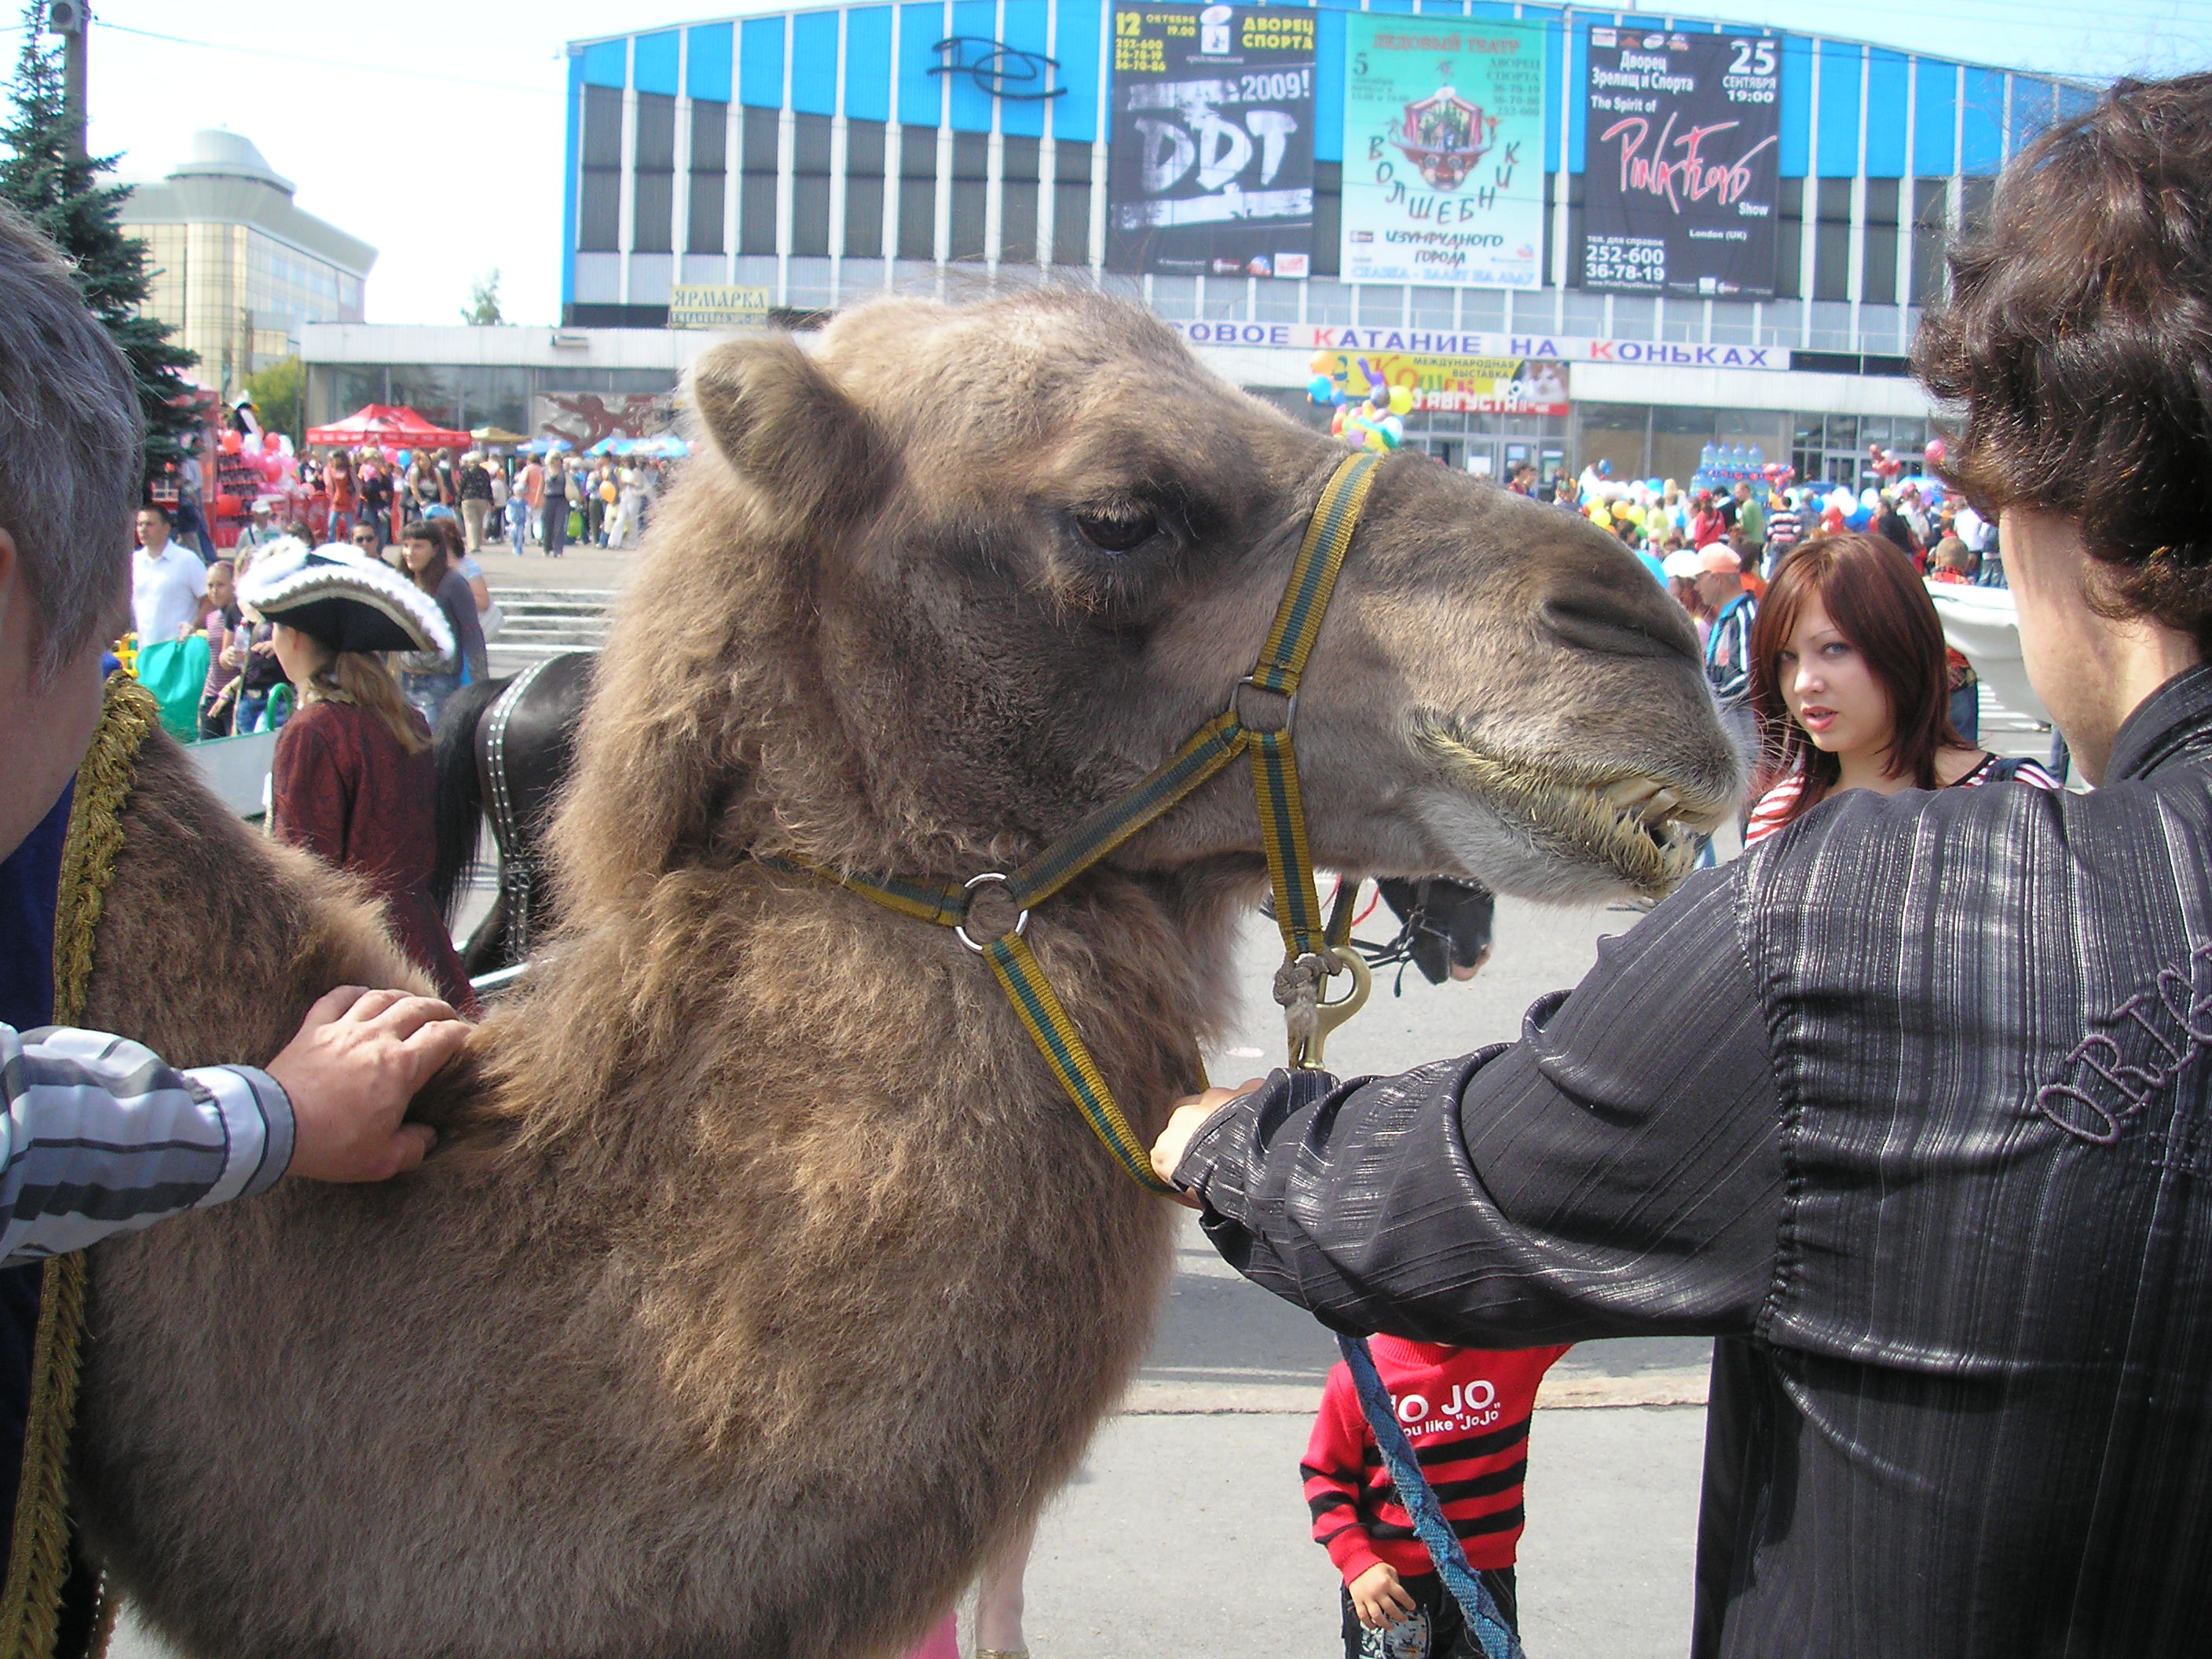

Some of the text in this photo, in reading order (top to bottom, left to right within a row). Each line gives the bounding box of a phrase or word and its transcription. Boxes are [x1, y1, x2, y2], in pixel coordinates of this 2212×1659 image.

[1116, 12, 1196, 36] 12 ОКТЯБРЯ
[1167, 25, 1196, 36] 19.00
[1243, 16, 1314, 35] ДВОРЕЦ
[1115, 38, 1163, 49] 252-600
[1242, 33, 1313, 49] СПОРТА
[1373, 34, 1520, 54] ЛЕДОВЫЙ ТЕАТР
[1353, 52, 1368, 75] 5
[1619, 50, 1667, 74] Дворец
[1729, 41, 1775, 76] 25
[1241, 69, 1310, 101] 2009!
[1591, 67, 1694, 93] Зрелищ и Спорта
[1722, 76, 1776, 90] СЕНТЯБРЯ
[1591, 95, 1657, 112] The Spirit of
[1727, 90, 1774, 103] 19:00
[1738, 201, 1770, 217] Show
[1386, 230, 1503, 250] ИЗУМРУДНОГО
[1587, 235, 1664, 247] тел. для справок
[1689, 229, 1747, 242] London (UK)
[1415, 250, 1467, 268] ГОРОДА
[1586, 245, 1664, 265] 252-600
[1586, 263, 1664, 281] 36-78-19
[674, 291, 765, 308] ЯРМАРКА
[1313, 327, 1481, 353] КАТАНИЕ
[1511, 338, 1558, 357] НА
[1590, 340, 1769, 366] КОНЬКАХ
[1413, 357, 1515, 368] МЕЖДУНАРОДНАЯ
[1452, 369, 1510, 379] ВЫСТАВКА
[1426, 391, 1518, 412] АВГУСТА
[1390, 1380, 1496, 1423] O JO
[1403, 1402, 1501, 1437] ou like "JoJo"
